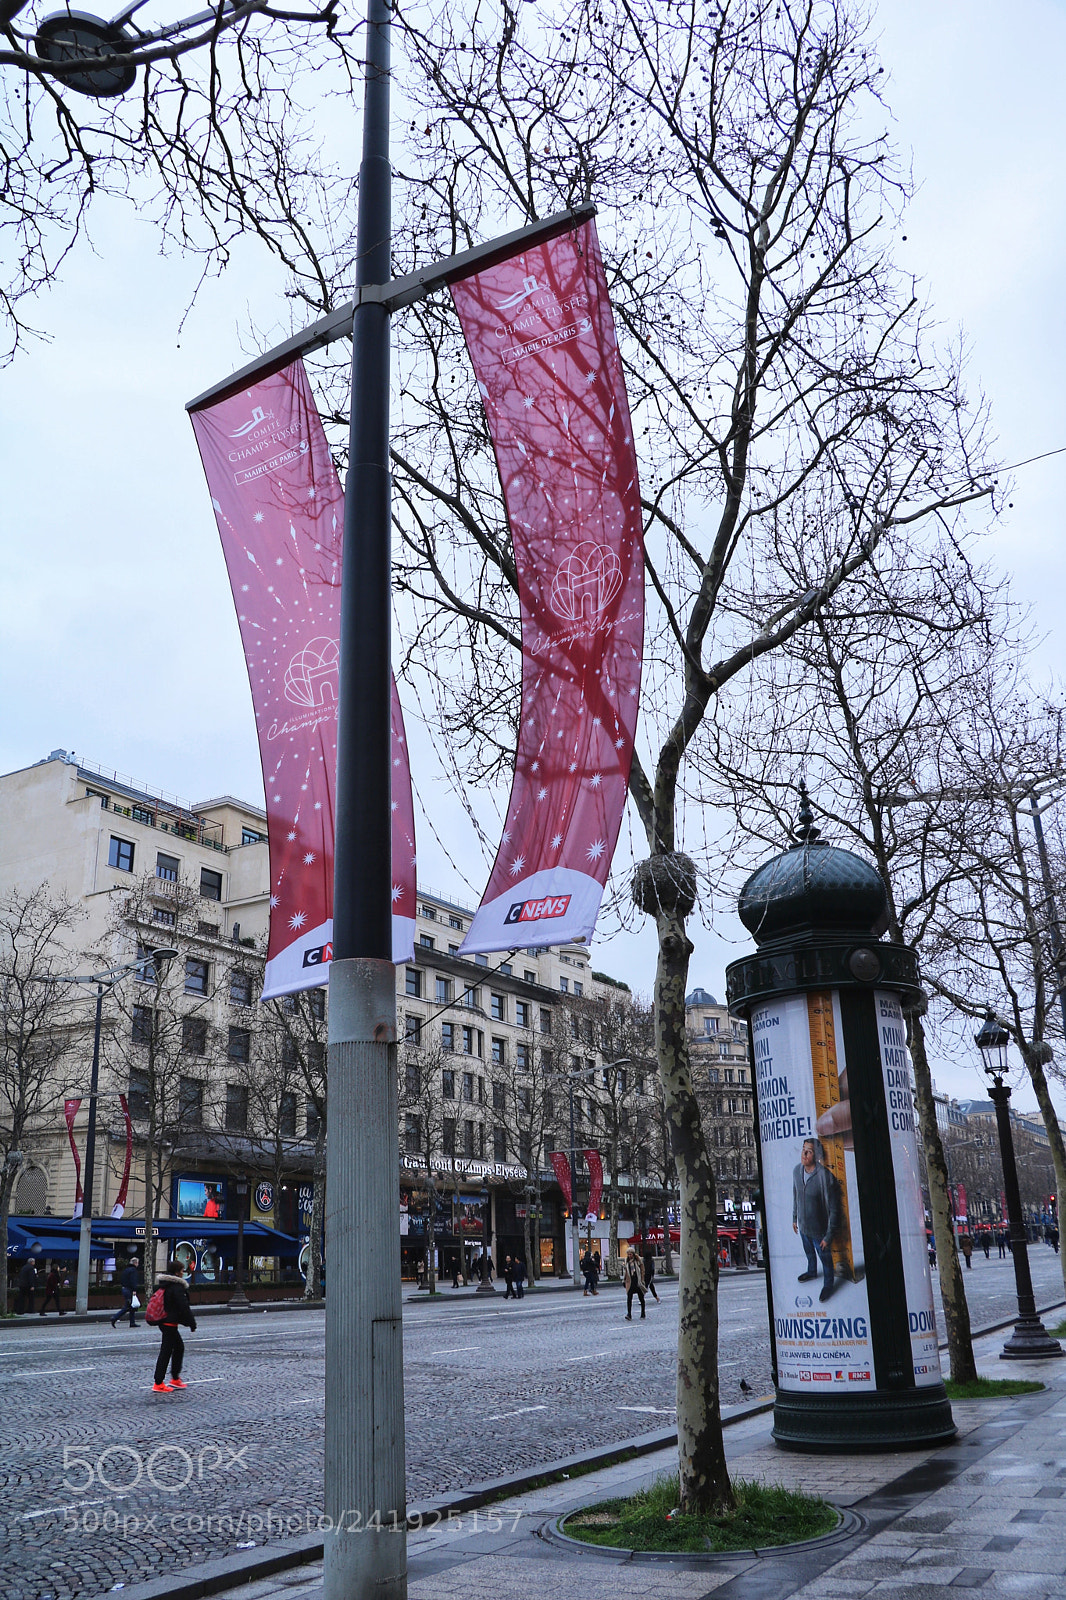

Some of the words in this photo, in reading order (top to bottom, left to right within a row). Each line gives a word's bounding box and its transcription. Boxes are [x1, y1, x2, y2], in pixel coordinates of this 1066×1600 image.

[512, 341, 540, 358] MAIRIE
[541, 337, 553, 347] DE
[554, 327, 577, 342] PARIS
[244, 464, 269, 479] MAIRIE
[269, 459, 278, 468] DE
[279, 449, 298, 464] PARIS
[509, 898, 567, 921] CNEWS
[753, 1017, 780, 1033] DAMON
[884, 1047, 907, 1068] MATT
[761, 1116, 812, 1143] COMÉDIE!
[909, 1310, 935, 1332] DOW
[822, 1350, 851, 1358] CINÉMA
